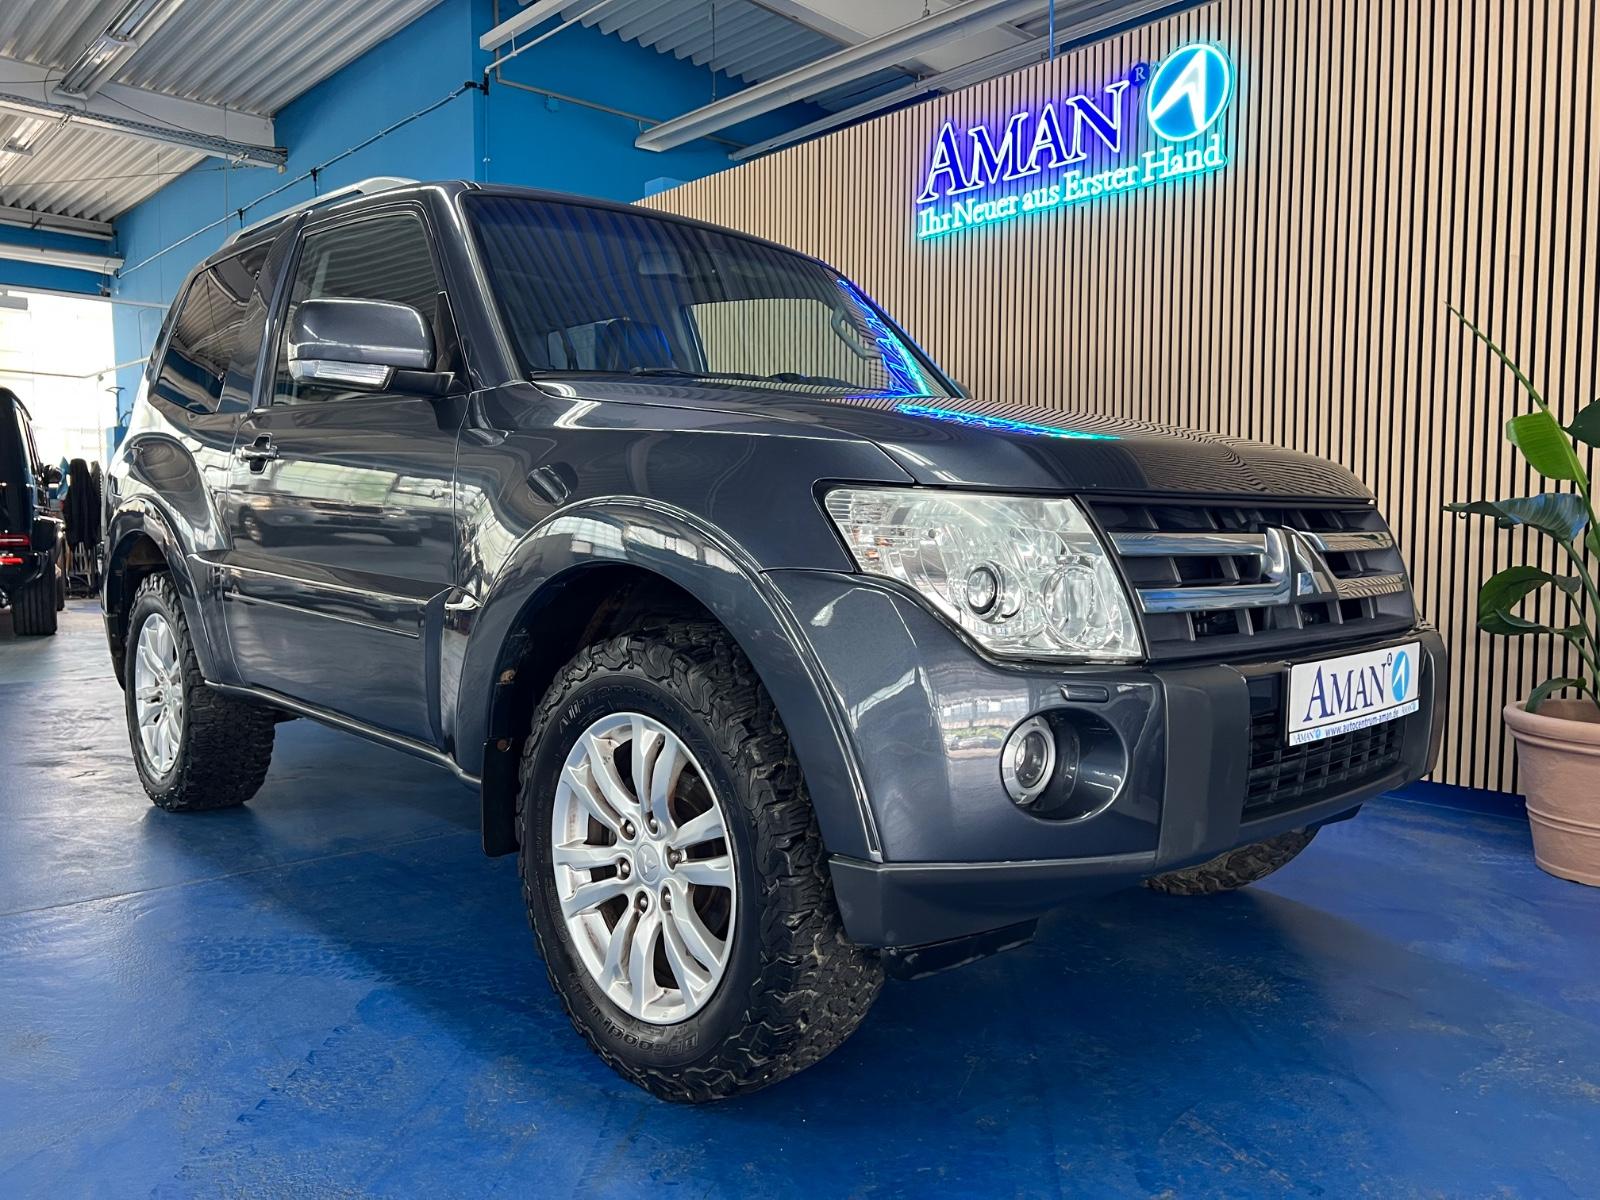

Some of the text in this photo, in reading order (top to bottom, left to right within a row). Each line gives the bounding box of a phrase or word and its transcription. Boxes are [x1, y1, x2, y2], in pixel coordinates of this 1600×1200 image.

[916, 79, 1130, 204] AMAN
[918, 134, 1223, 238] Ihr Neuer aus Erster Hand
[1303, 664, 1386, 722] AMAN
[1325, 709, 1399, 737] www.autocentrum-aman.de
